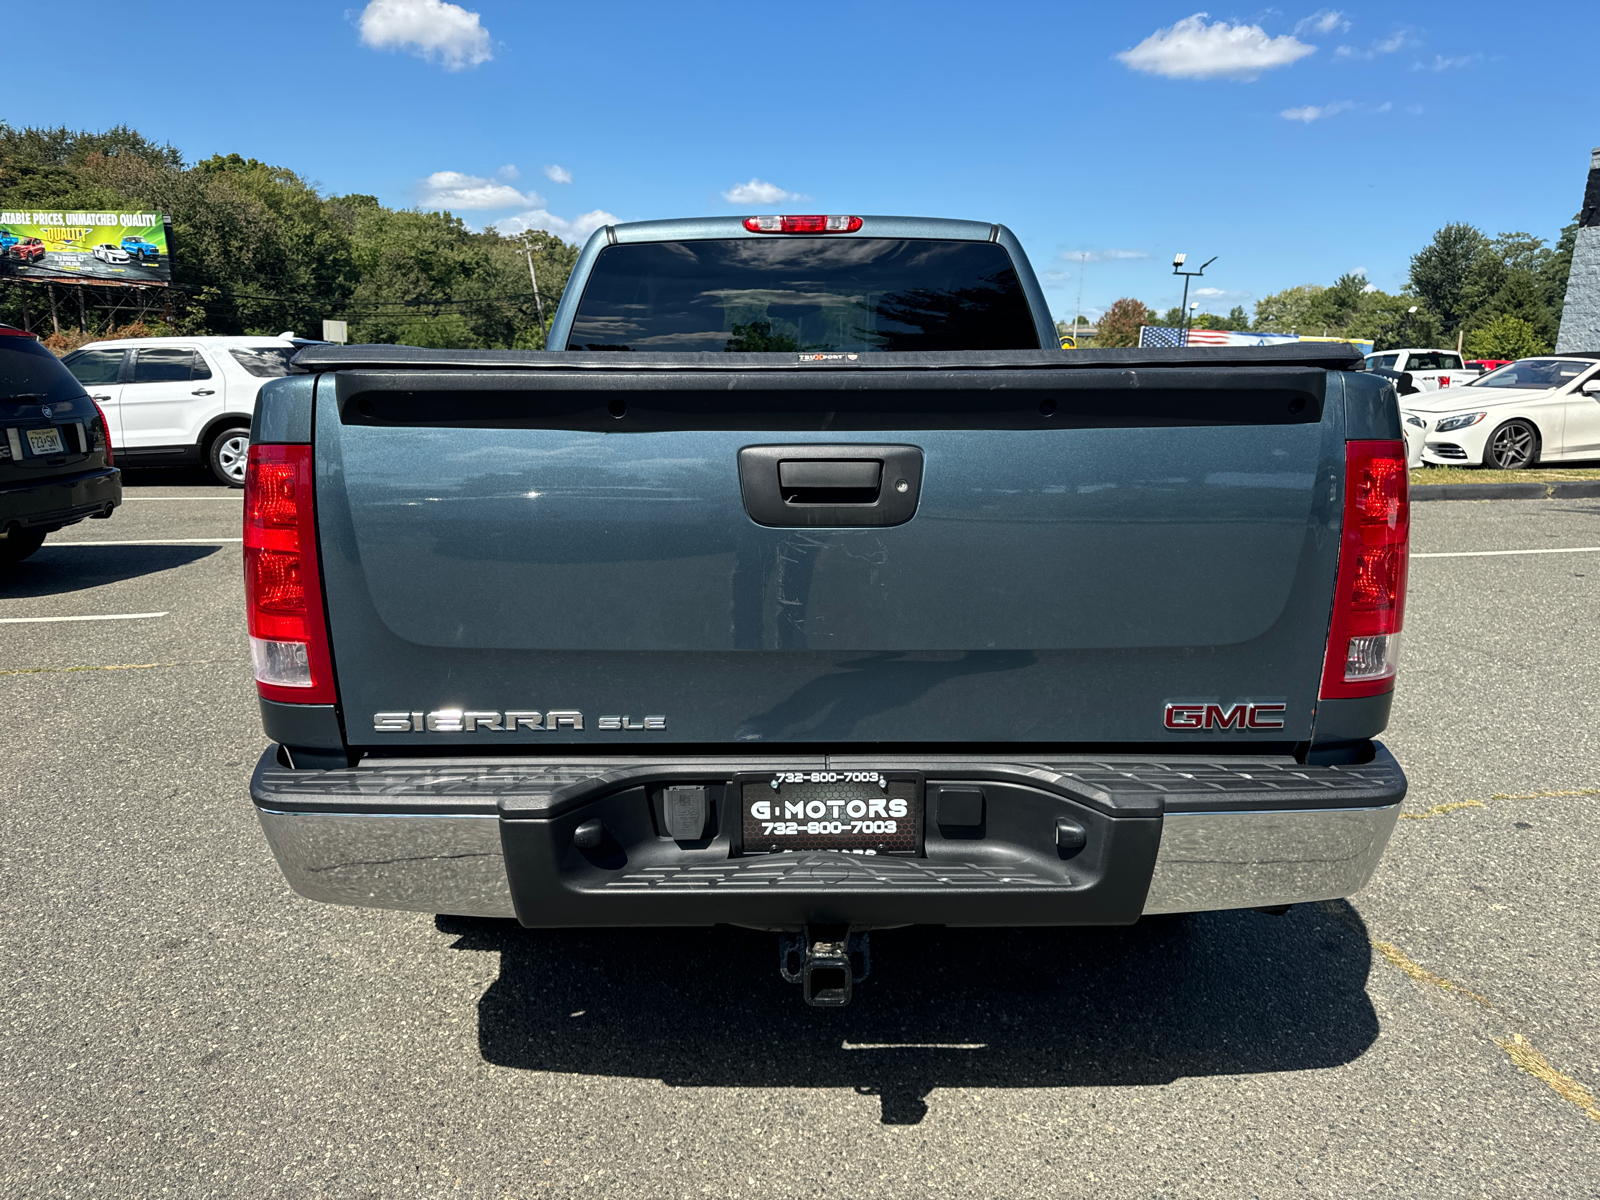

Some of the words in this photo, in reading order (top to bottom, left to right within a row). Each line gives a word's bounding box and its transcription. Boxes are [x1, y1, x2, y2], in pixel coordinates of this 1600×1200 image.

[32, 212, 65, 227] PRICES,
[65, 213, 118, 226] UNMATCHED
[120, 214, 156, 227] QUALITY
[47, 227, 86, 244] QUALITY
[373, 709, 585, 732] SIERRA
[598, 714, 667, 730] SLE
[1164, 702, 1287, 729] GMC
[776, 772, 879, 784] 732-800-7003
[761, 820, 897, 835] 732-800-7003
